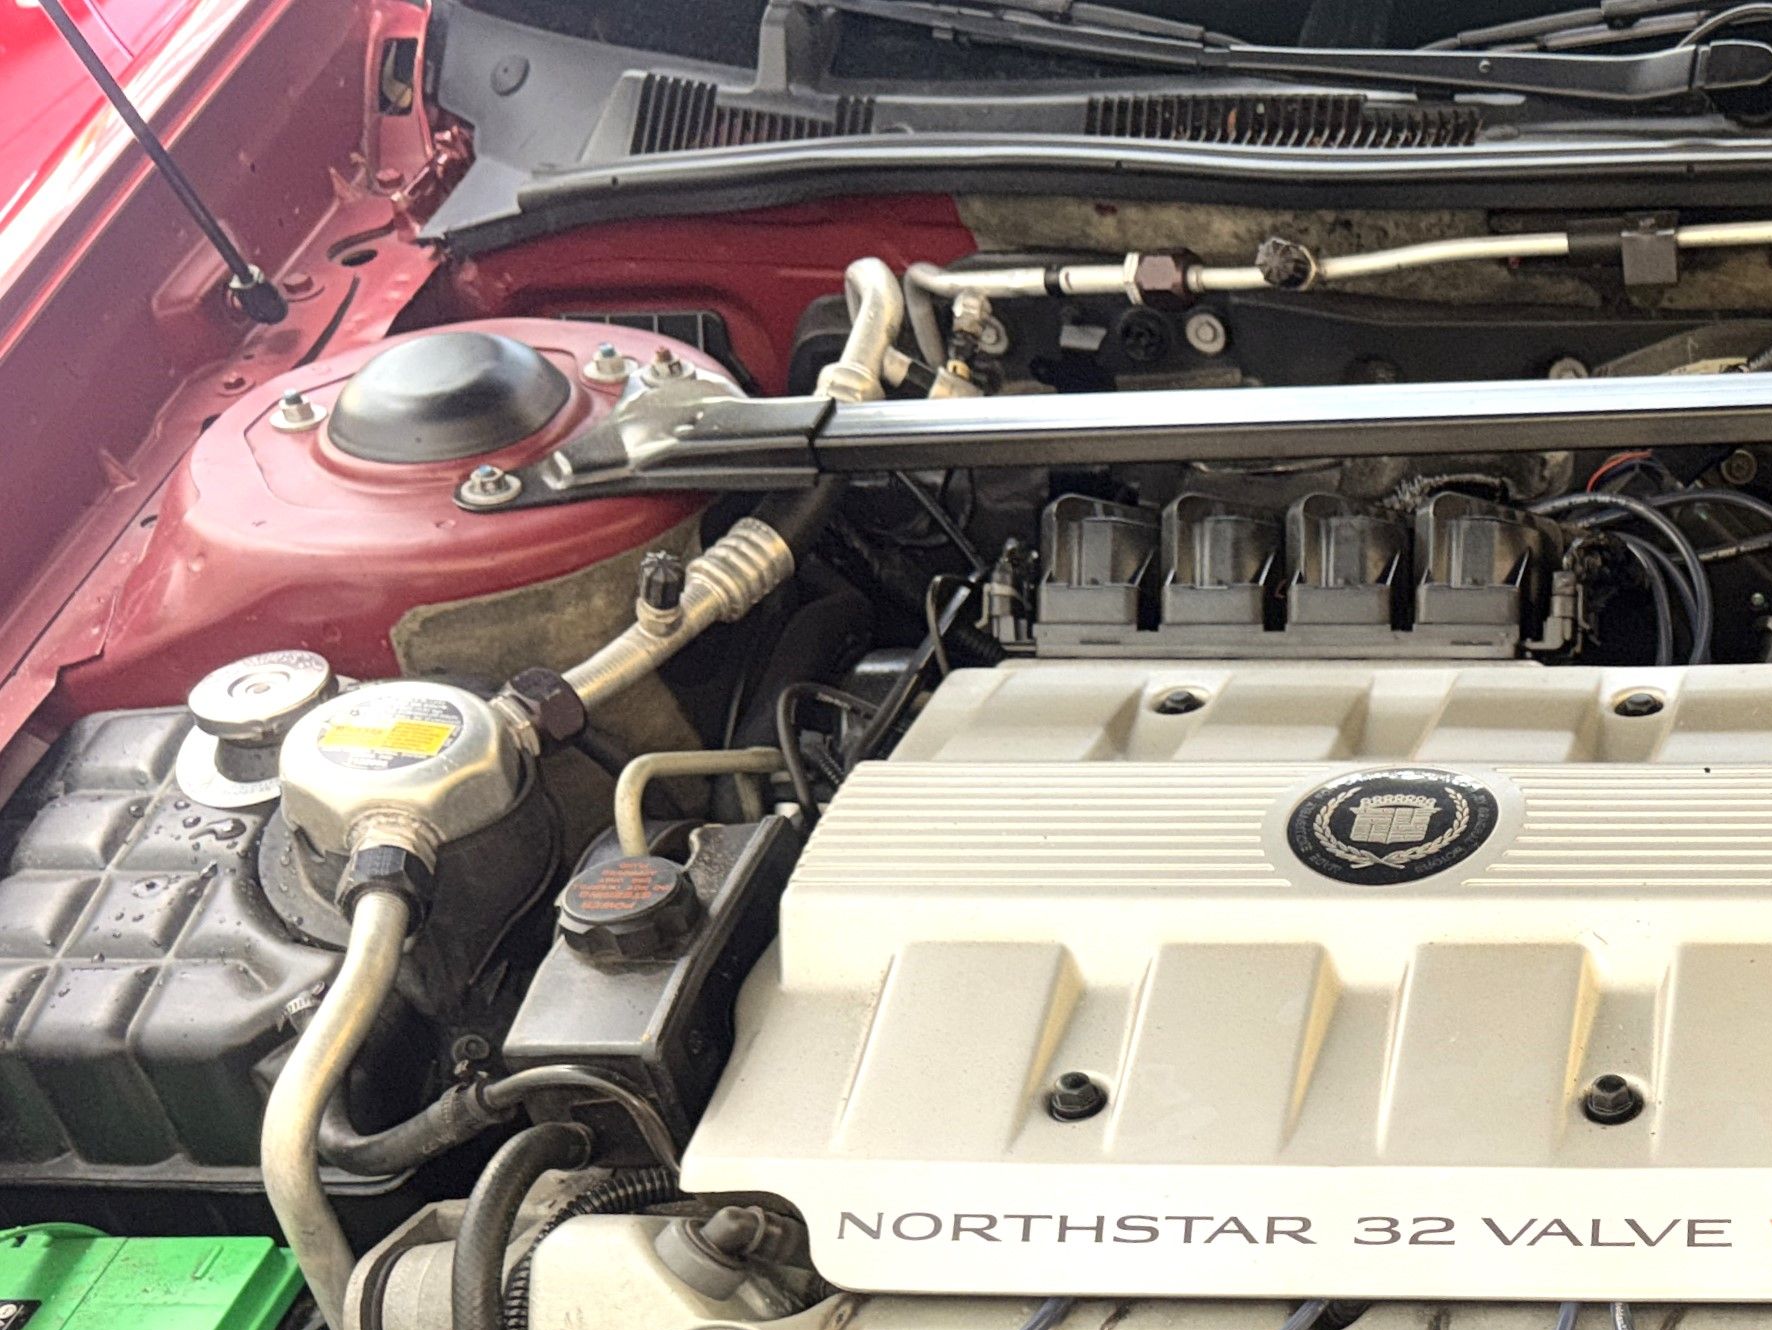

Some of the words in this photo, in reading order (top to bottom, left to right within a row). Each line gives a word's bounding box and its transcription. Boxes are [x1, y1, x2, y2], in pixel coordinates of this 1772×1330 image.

[836, 1211, 1317, 1245] NORTHSTAR
[1353, 1216, 1456, 1247] 32
[1480, 1217, 1733, 1248] VALVE
